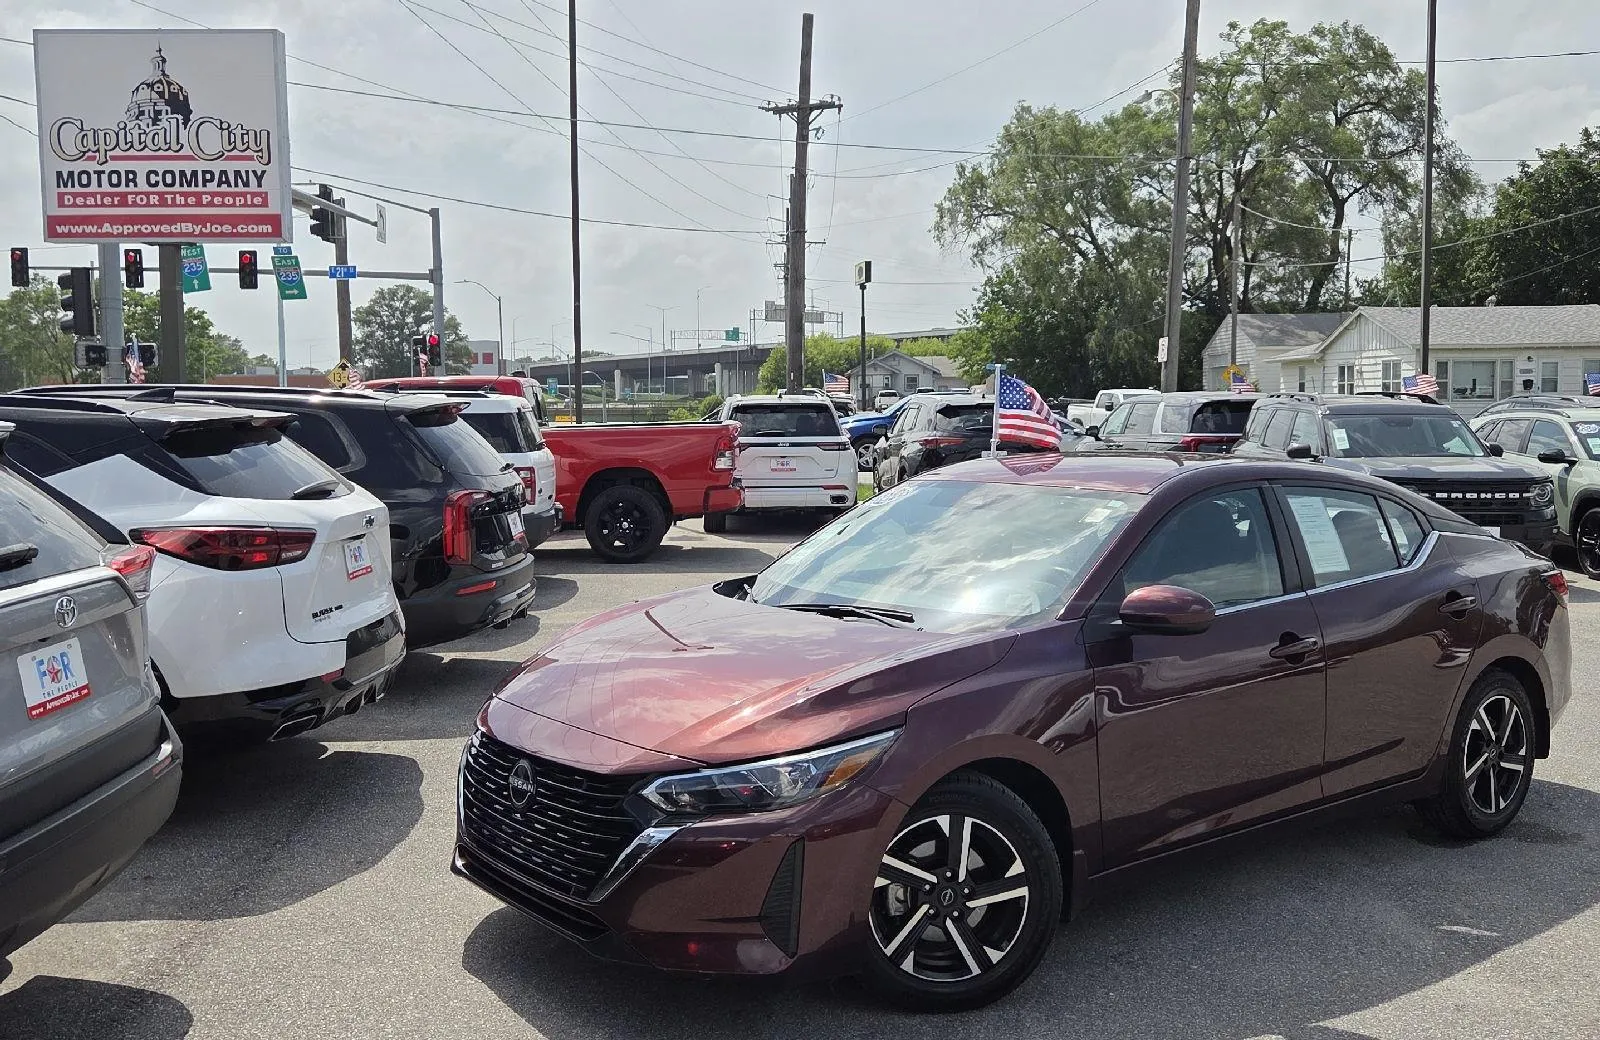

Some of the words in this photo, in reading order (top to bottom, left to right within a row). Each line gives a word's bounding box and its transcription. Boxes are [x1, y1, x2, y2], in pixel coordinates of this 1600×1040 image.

[50, 115, 184, 165] Capital
[188, 117, 271, 165] City
[56, 170, 137, 188] MOTOR
[146, 169, 267, 188] COMPANY
[64, 194, 121, 206] Dealer
[128, 194, 160, 205] FOR
[165, 194, 197, 205] The
[202, 193, 263, 207] People
[56, 222, 272, 235] www.ApprovedByJoe.com
[184, 261, 203, 273] 235
[274, 257, 296, 266] EAST
[280, 271, 299, 281] 235
[36, 651, 75, 690] FOR
